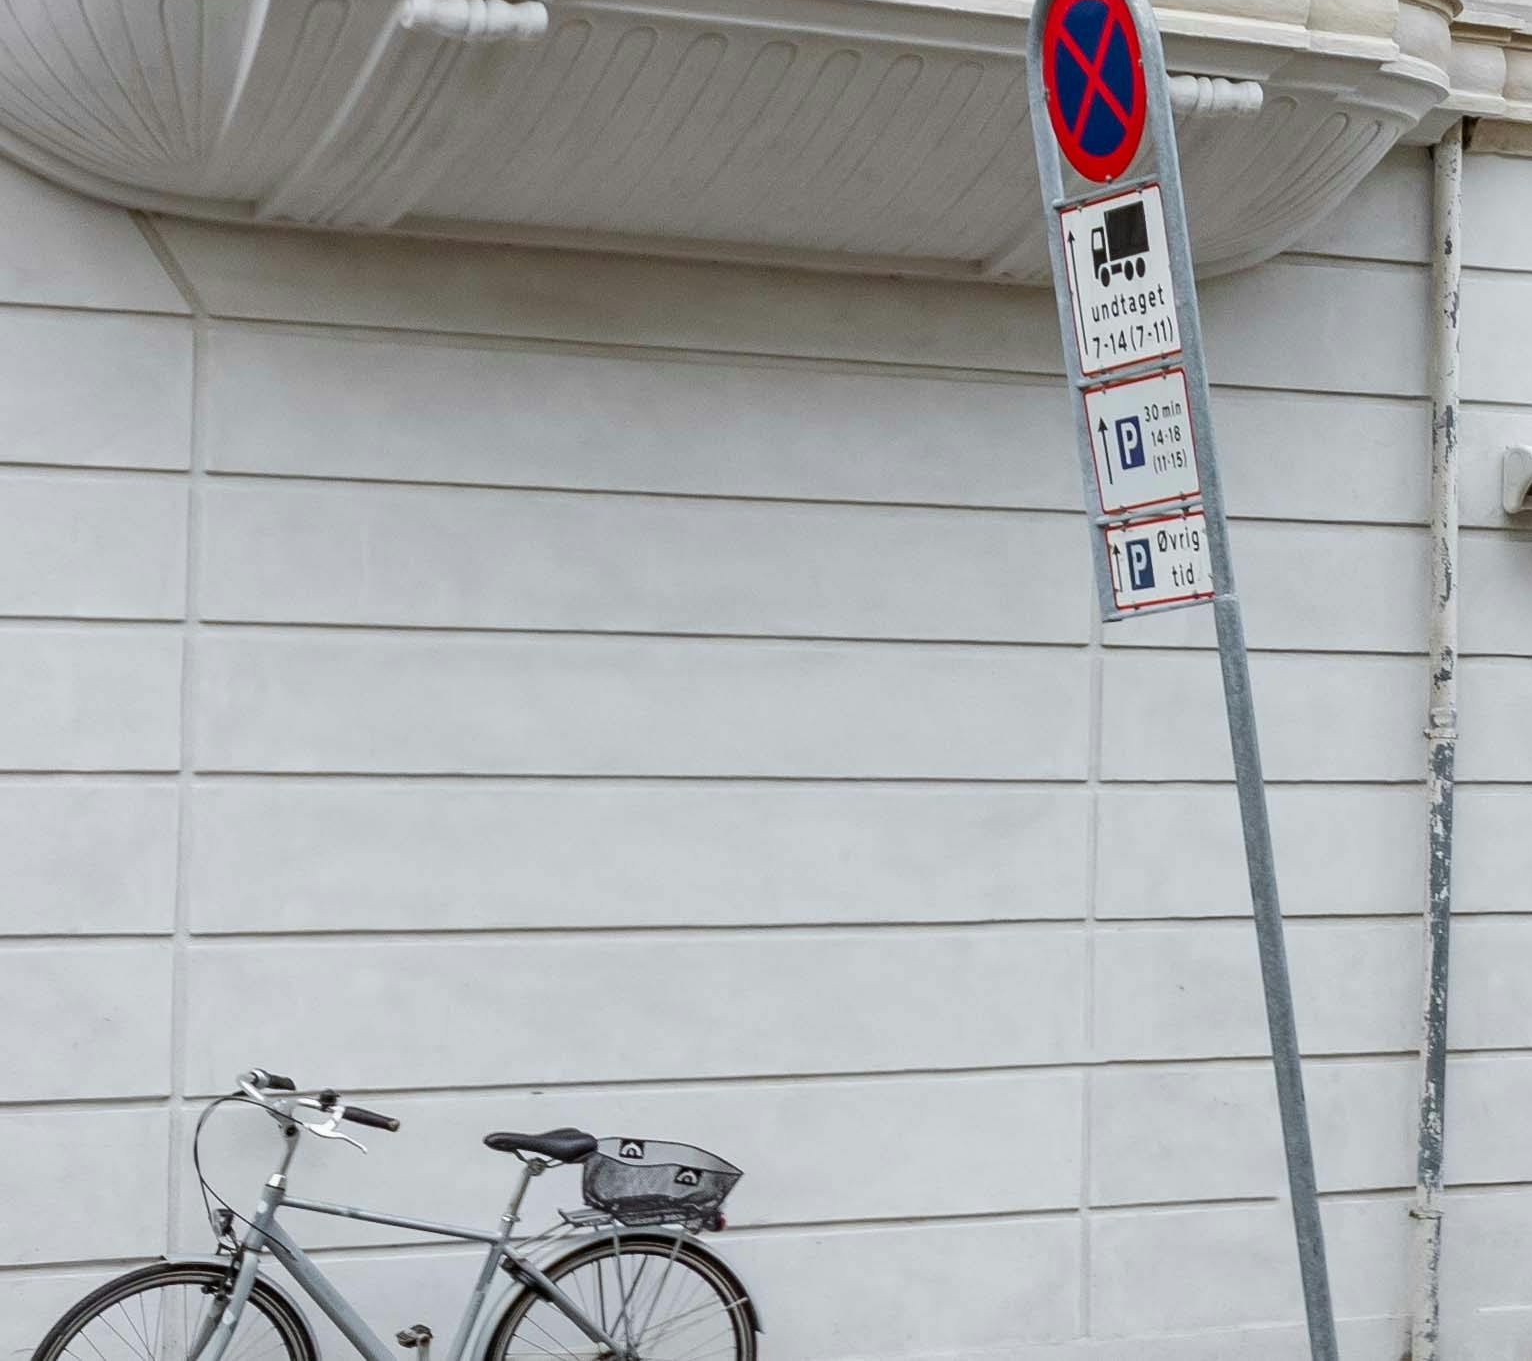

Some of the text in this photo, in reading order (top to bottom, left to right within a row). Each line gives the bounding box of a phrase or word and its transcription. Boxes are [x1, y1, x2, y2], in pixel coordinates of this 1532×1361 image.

[1091, 283, 1165, 322] undtaget
[1143, 400, 1182, 423] 30 min
[1151, 425, 1182, 447] 14-18
[1153, 448, 1188, 474] (11-15)
[1156, 527, 1200, 553] Øvrig
[1171, 563, 1195, 587] tid
